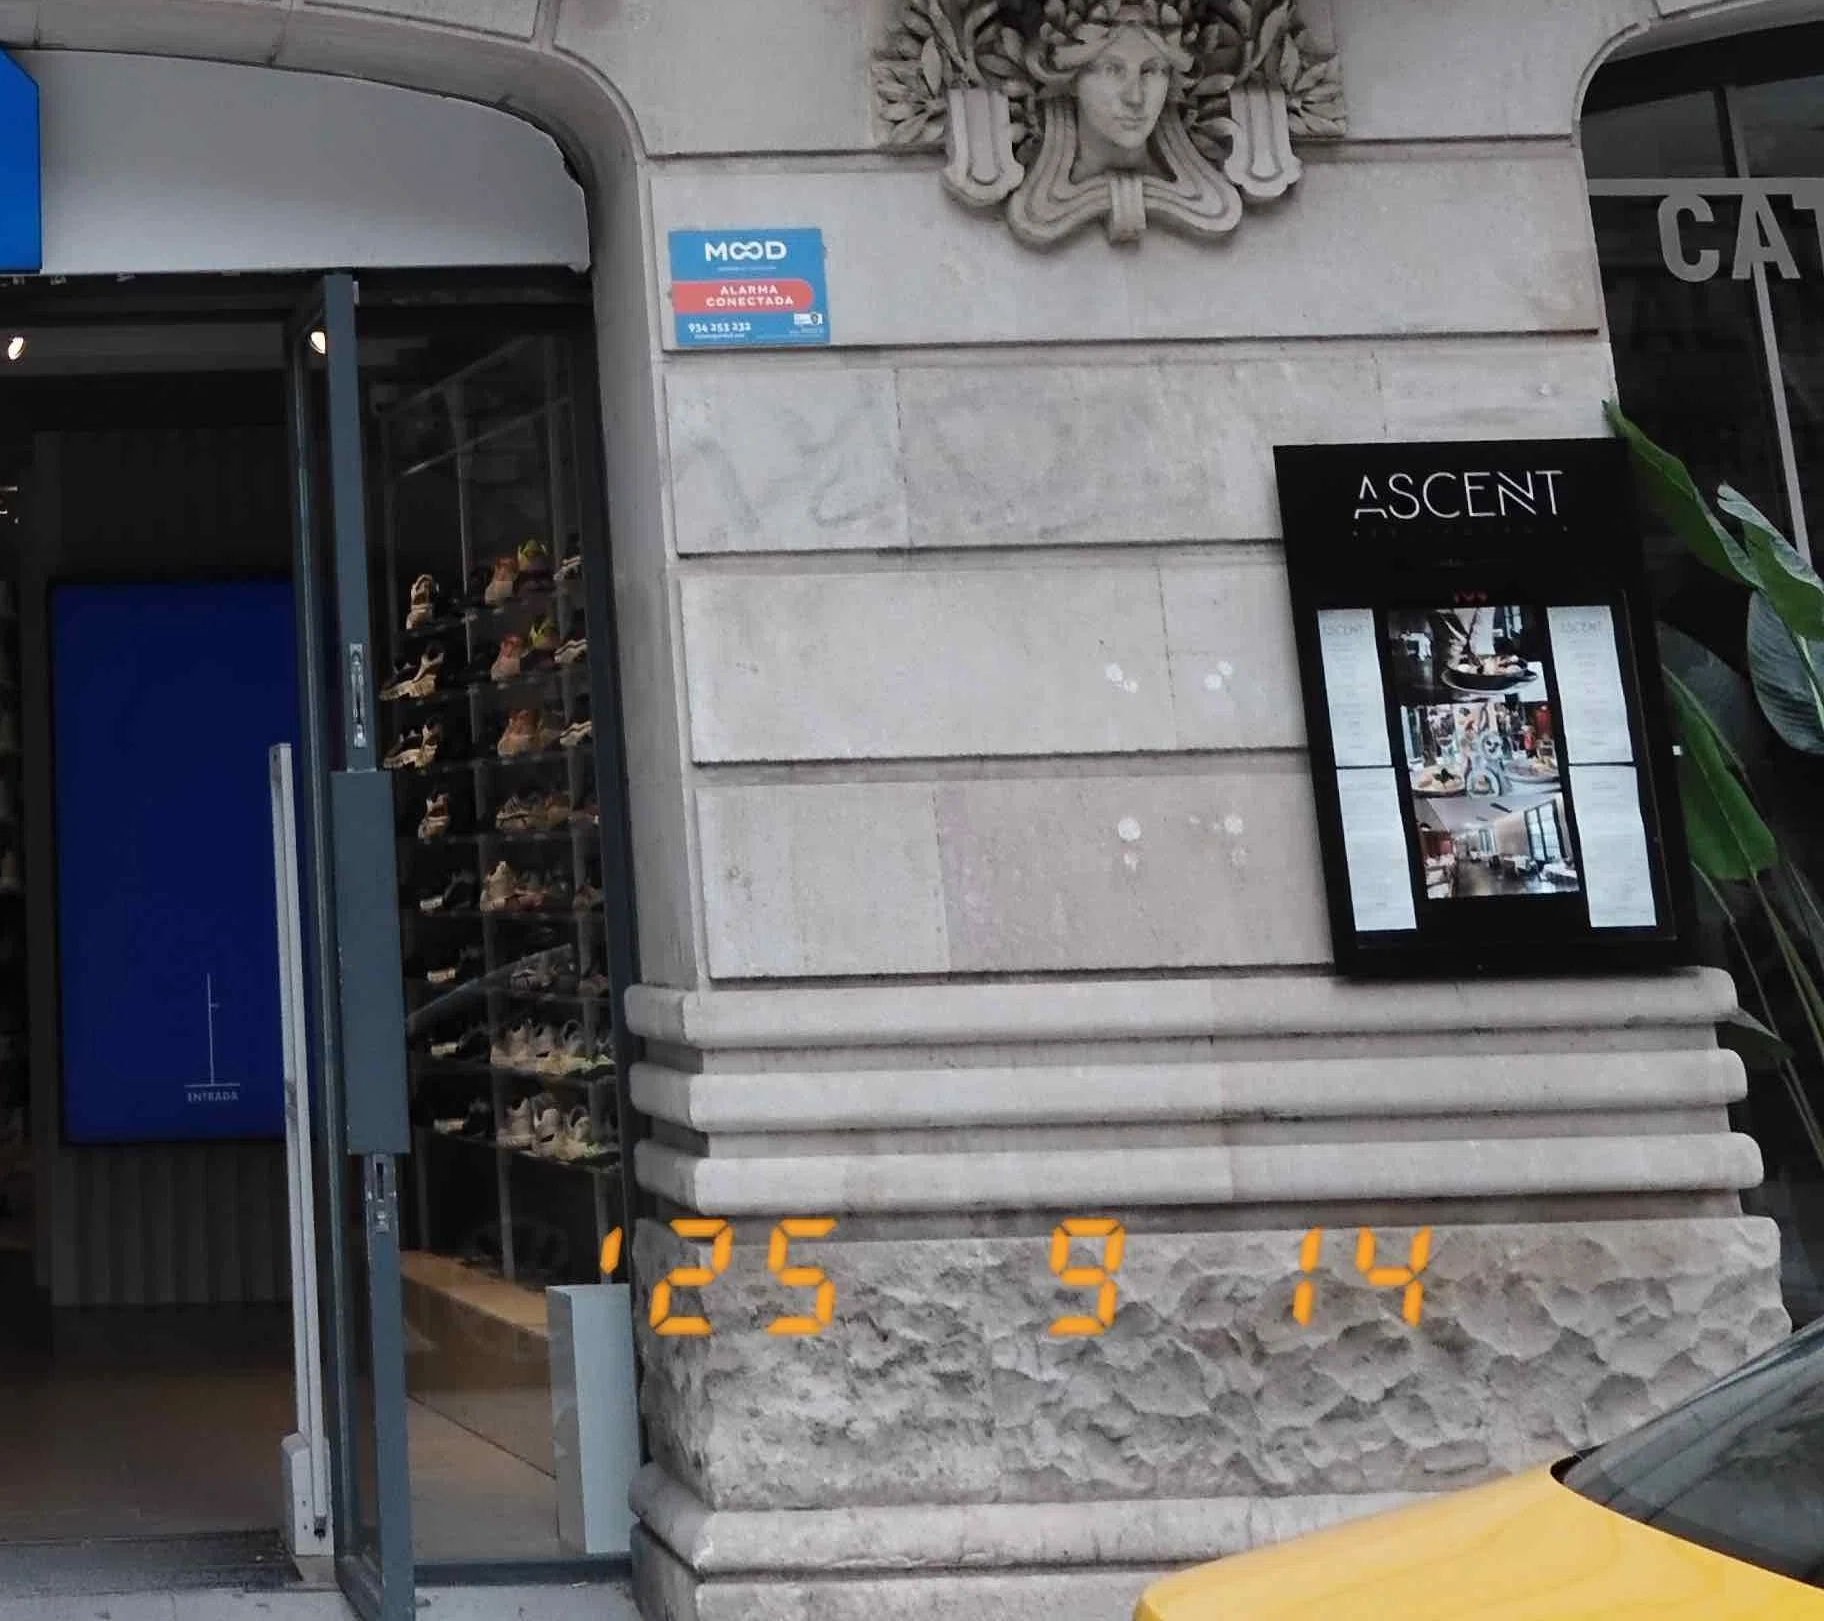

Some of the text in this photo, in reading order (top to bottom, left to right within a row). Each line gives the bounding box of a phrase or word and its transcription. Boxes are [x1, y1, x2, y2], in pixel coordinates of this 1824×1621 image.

[704, 241, 788, 262] MOOD
[720, 284, 779, 295] ALARMA
[705, 296, 794, 307] CONECTADA
[1352, 469, 1565, 520] ASCENT
[187, 1090, 240, 1103] ENTRADA
